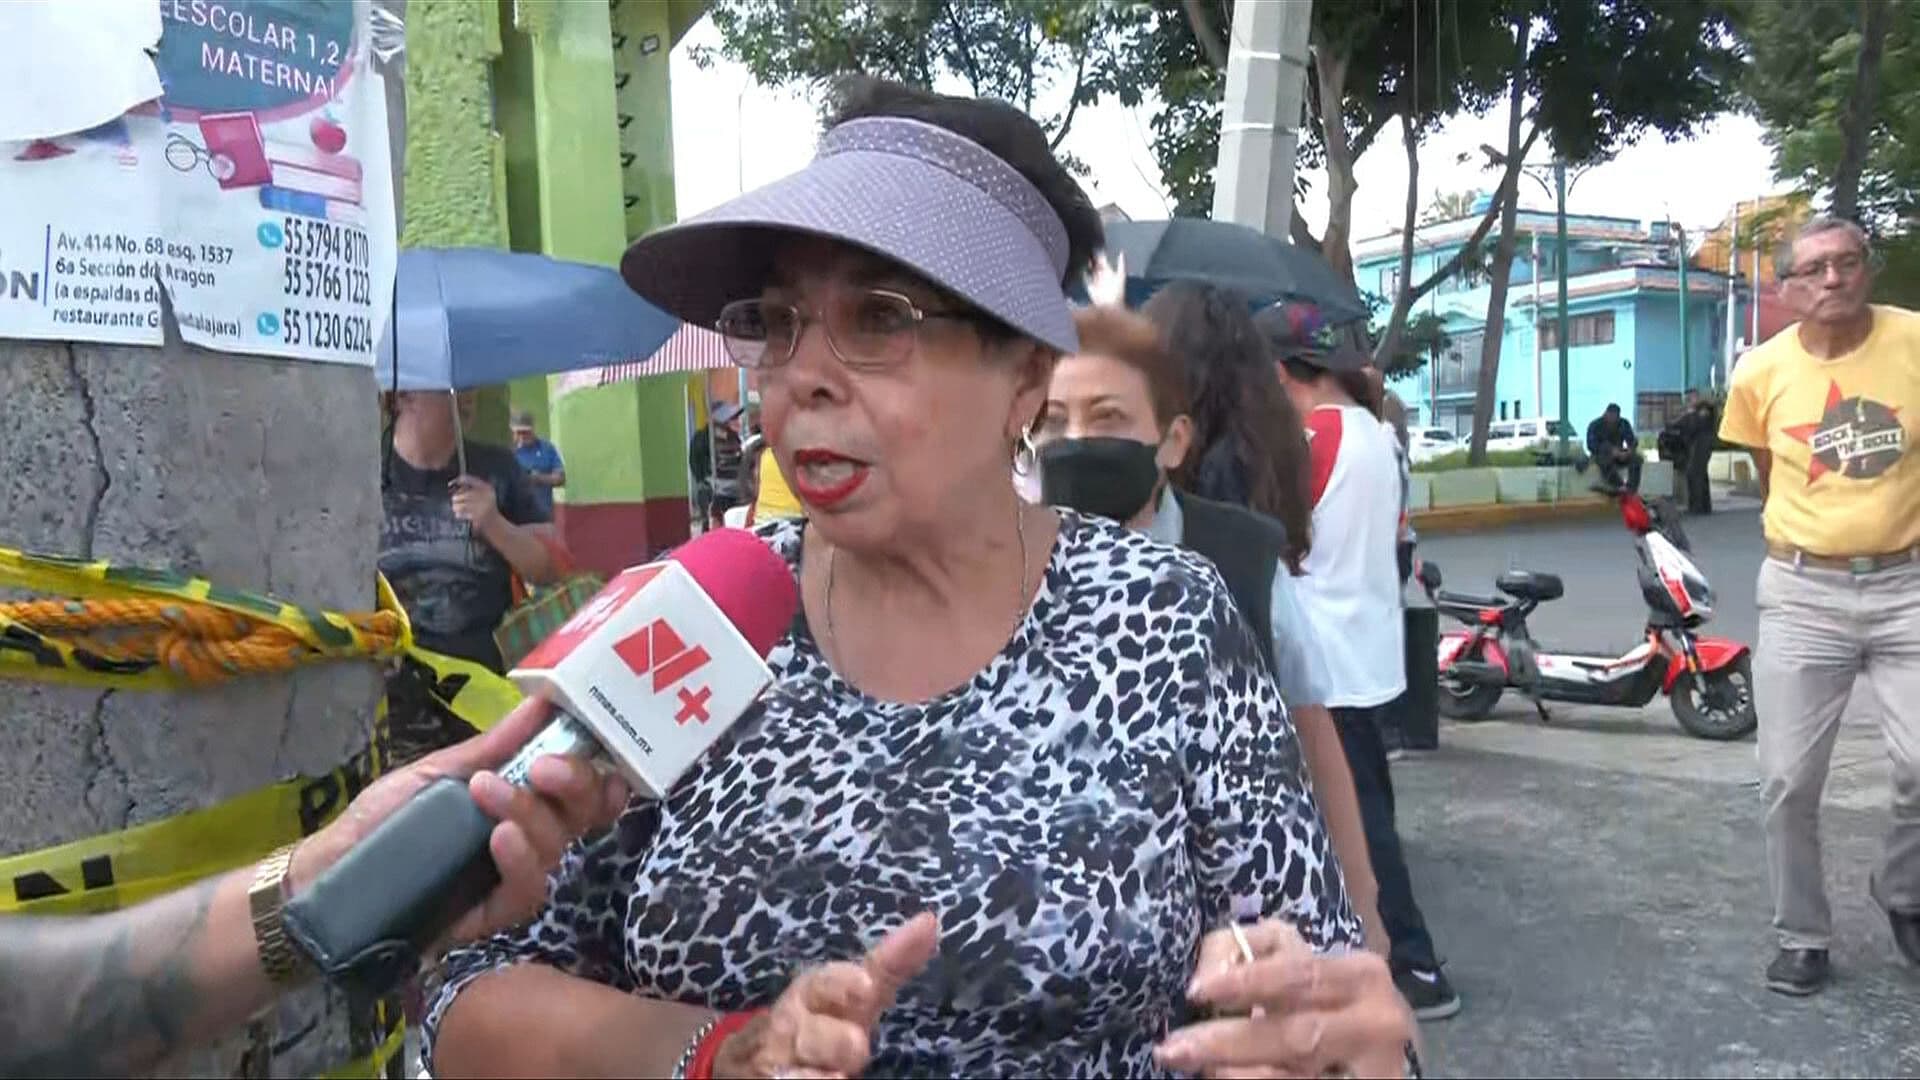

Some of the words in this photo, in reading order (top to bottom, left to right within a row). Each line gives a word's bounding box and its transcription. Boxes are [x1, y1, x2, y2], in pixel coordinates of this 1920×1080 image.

[57, 232, 81, 251] Av.
[84, 233, 112, 252] 414
[115, 233, 141, 254] No.
[144, 236, 164, 255] 68
[167, 242, 196, 264] esq.
[200, 244, 233, 265] 1537
[284, 217, 302, 255] 55
[306, 221, 341, 261] 5794
[73, 283, 140, 305] espaldas
[284, 257, 301, 295] 55
[306, 261, 341, 301] 5766
[345, 267, 371, 306] 1232
[54, 308, 144, 328] restaurante
[284, 307, 301, 344] 55
[305, 311, 341, 349] 1230
[344, 315, 372, 353] 6224
